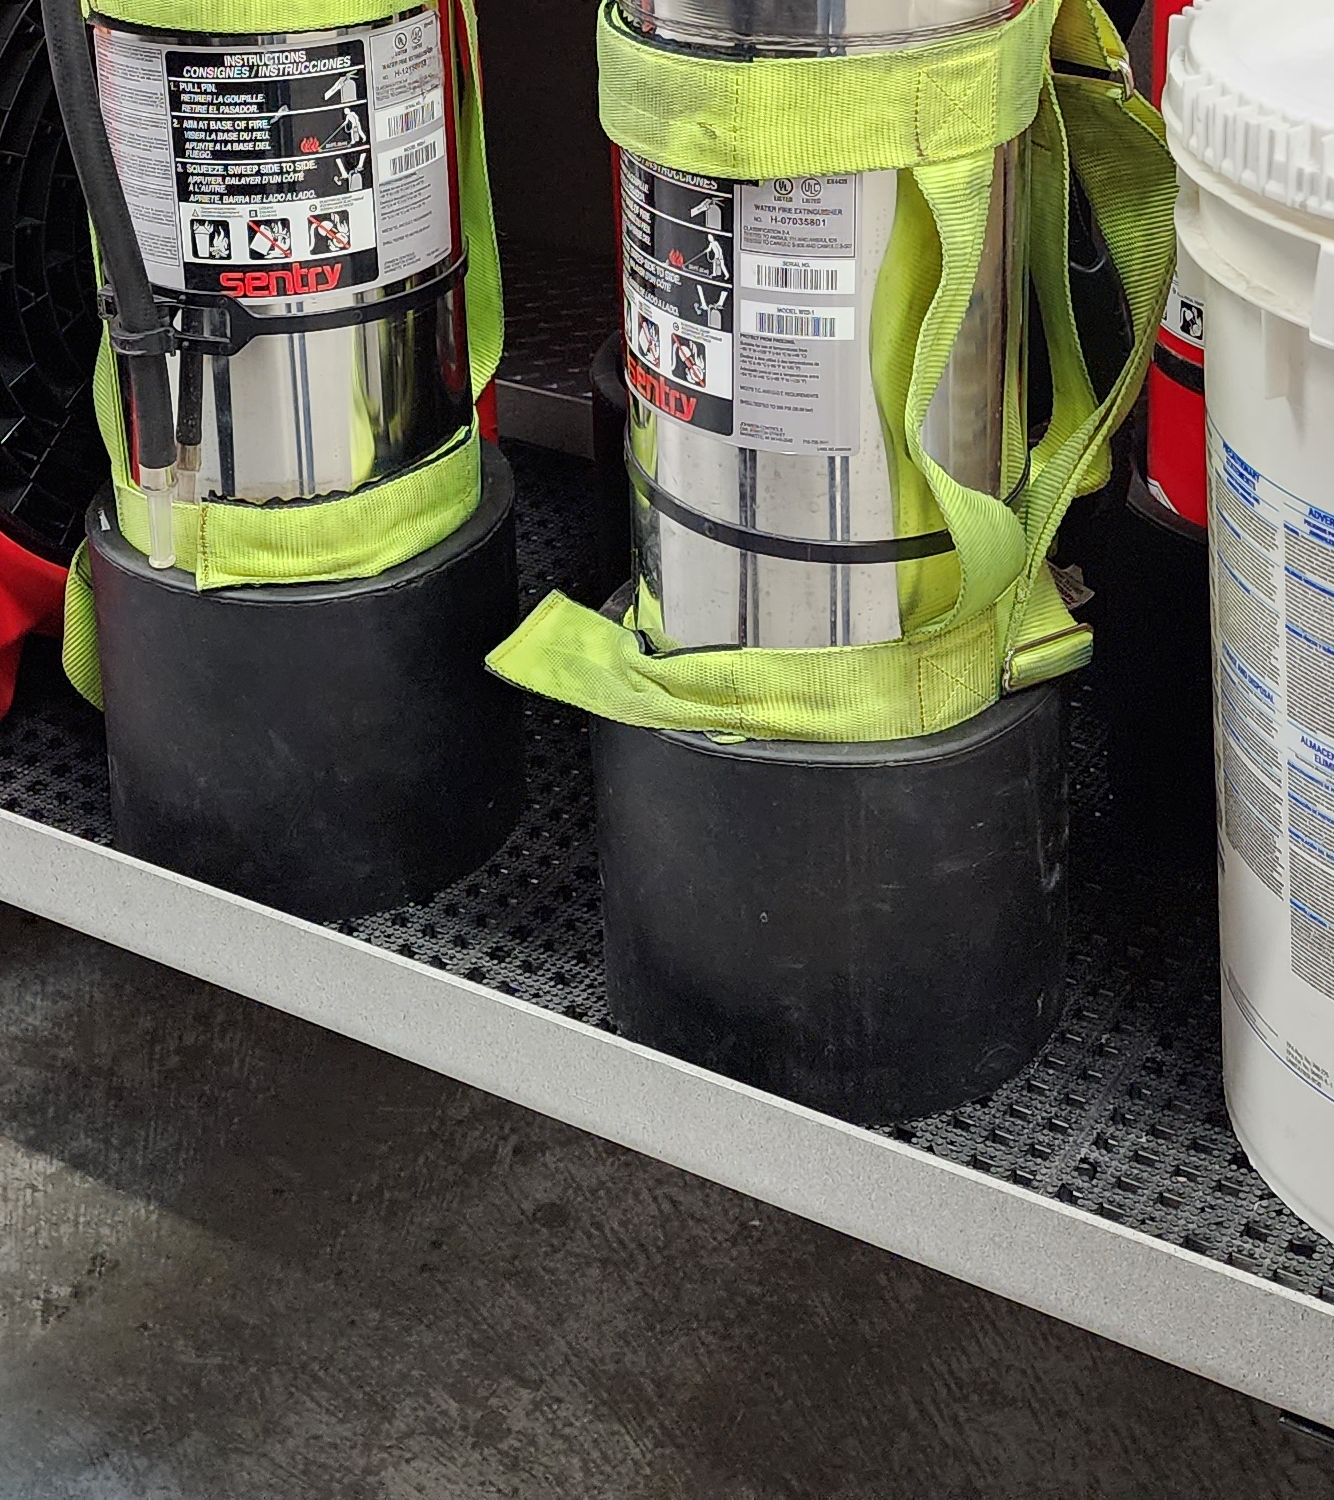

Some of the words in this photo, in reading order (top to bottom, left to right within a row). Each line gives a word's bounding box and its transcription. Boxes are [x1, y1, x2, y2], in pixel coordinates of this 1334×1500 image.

[224, 51, 307, 67] INSTRUCTIONS
[183, 66, 250, 78] CONSIGNES
[258, 56, 352, 77] INSTRUCCIONES
[180, 82, 200, 92] PULL
[213, 94, 224, 103] LA
[182, 104, 207, 113] RETIRE
[209, 105, 219, 113] EL
[183, 120, 197, 129] AIM
[198, 120, 209, 129] AT
[210, 120, 233, 130] BASE
[235, 120, 247, 130] OF
[240, 131, 251, 140] DU
[185, 142, 214, 150] APUNTE
[221, 142, 232, 151] LA
[228, 164, 258, 175] SWEEP
[259, 164, 280, 174] SIDE
[281, 162, 294, 173] TO
[251, 193, 262, 202] DE
[262, 192, 285, 202] LADO
[754, 203, 776, 213] WATER
[777, 205, 793, 214] FIRE
[794, 207, 843, 216] EXTINGUISHER
[220, 262, 342, 298] sentry
[777, 307, 797, 315] MODEL
[628, 357, 697, 421] sentry
